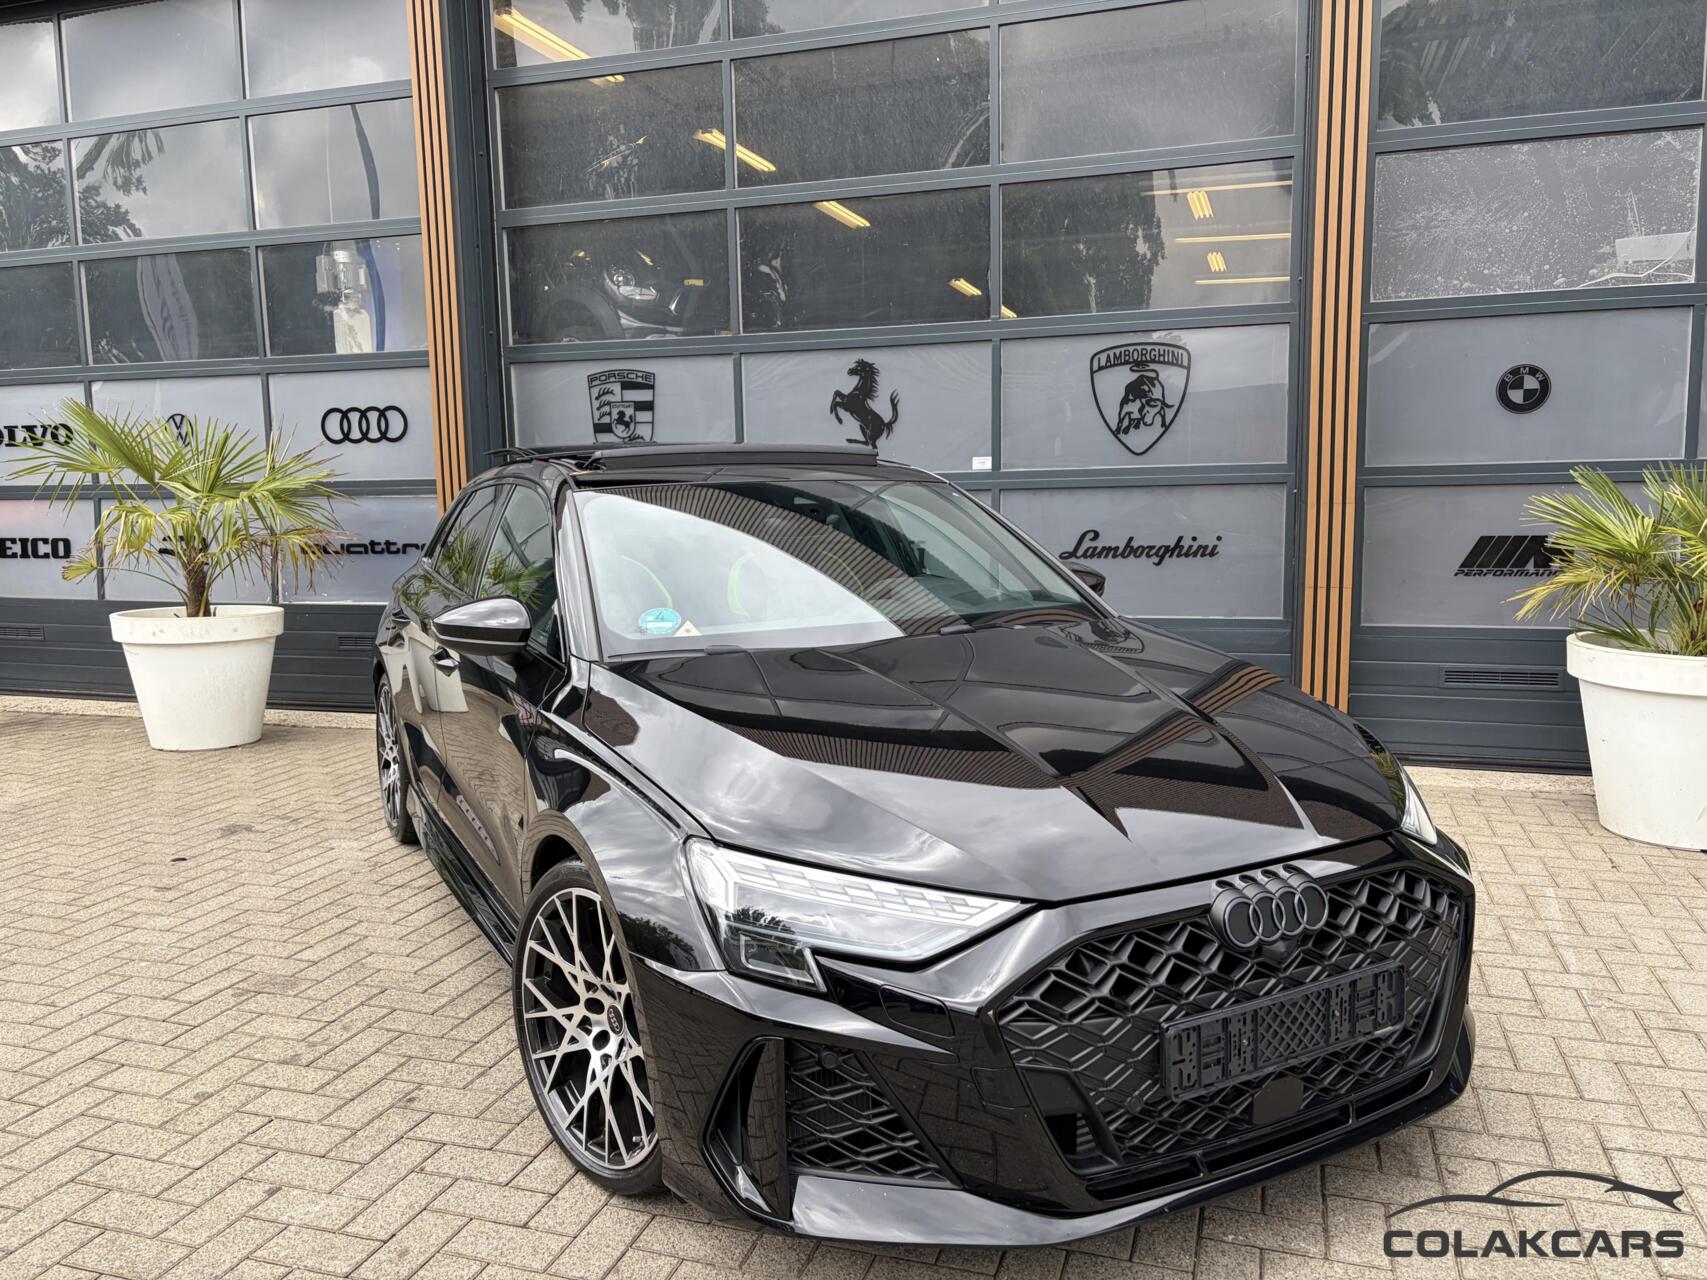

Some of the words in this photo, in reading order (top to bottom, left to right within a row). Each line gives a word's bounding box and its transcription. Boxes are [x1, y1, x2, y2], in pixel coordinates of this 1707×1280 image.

[1097, 347, 1185, 369] LAMBORGHINI
[590, 371, 653, 385] PORSCHE
[1503, 367, 1546, 382] BMW
[0, 423, 74, 447] LVO
[1058, 529, 1223, 567] Lamborghini
